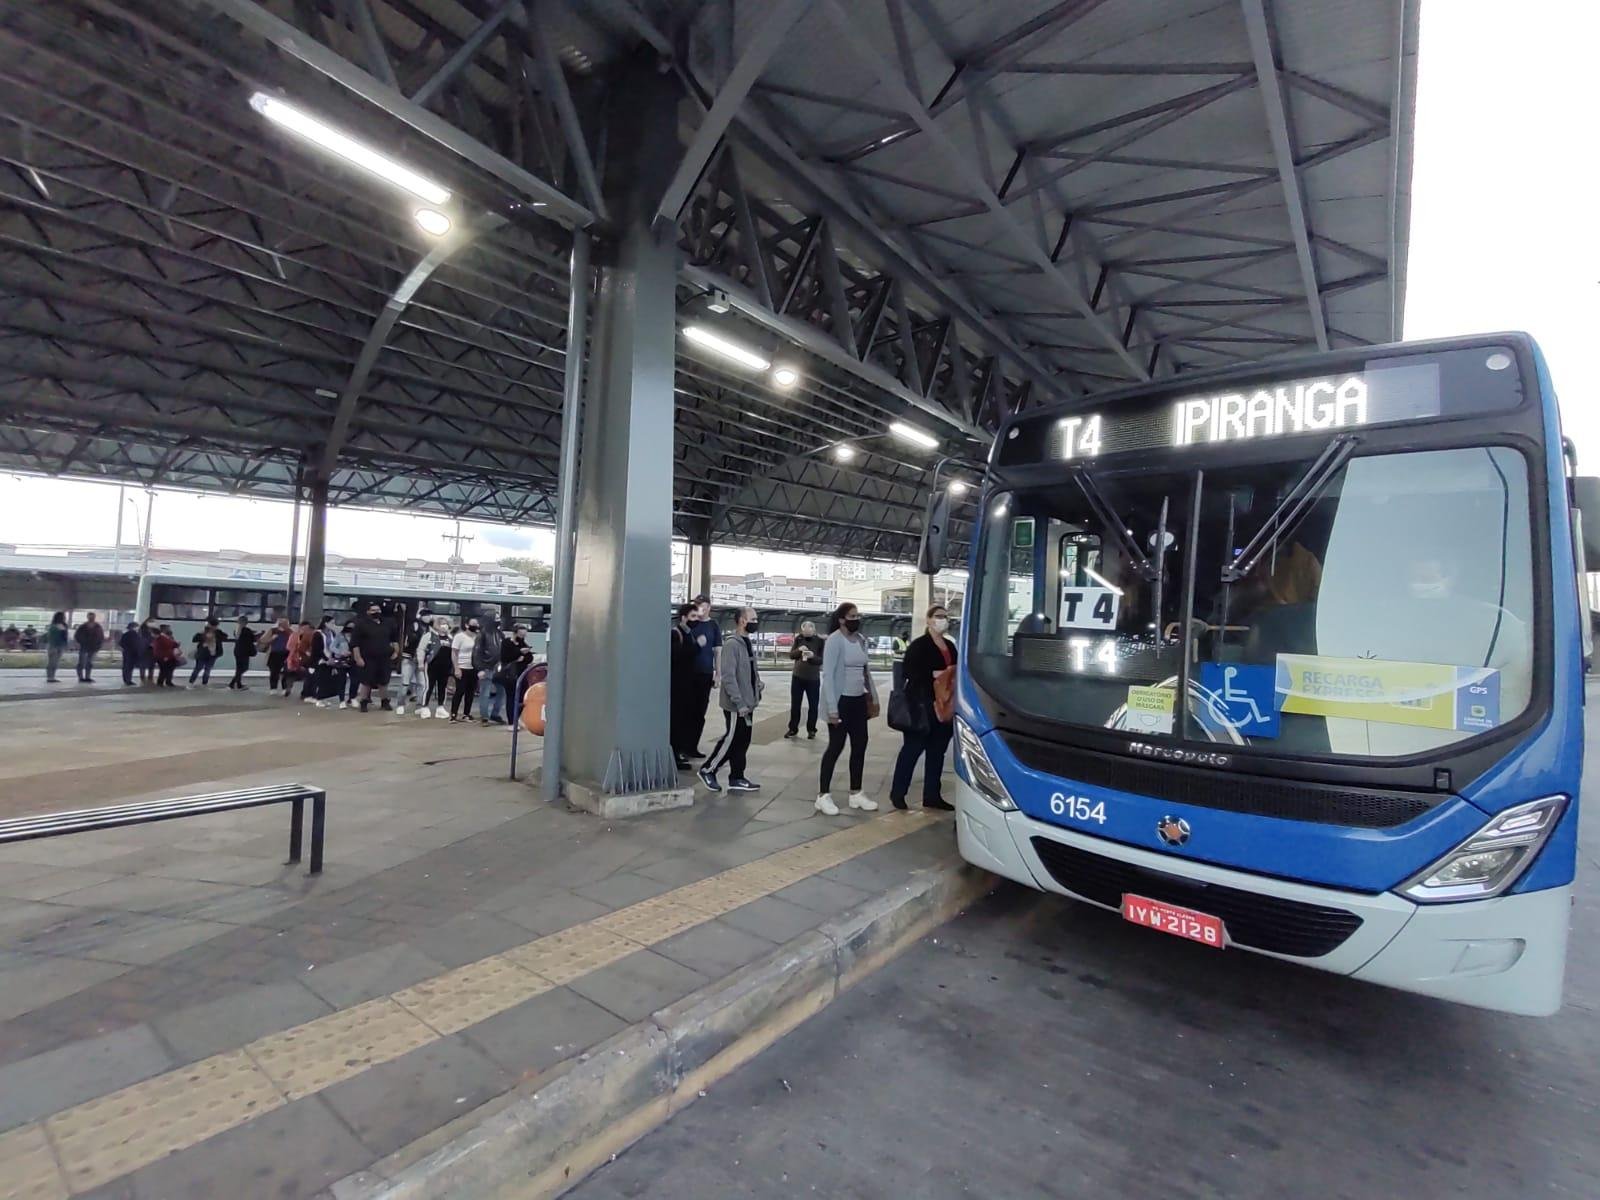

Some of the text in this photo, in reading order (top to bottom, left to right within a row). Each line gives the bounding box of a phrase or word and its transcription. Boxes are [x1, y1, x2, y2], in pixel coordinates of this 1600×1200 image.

[1059, 376, 1368, 459] T4 IPIRANGA
[1302, 671, 1384, 689] RECARGA
[1470, 686, 1488, 695] GPS
[1050, 792, 1107, 824] 6154
